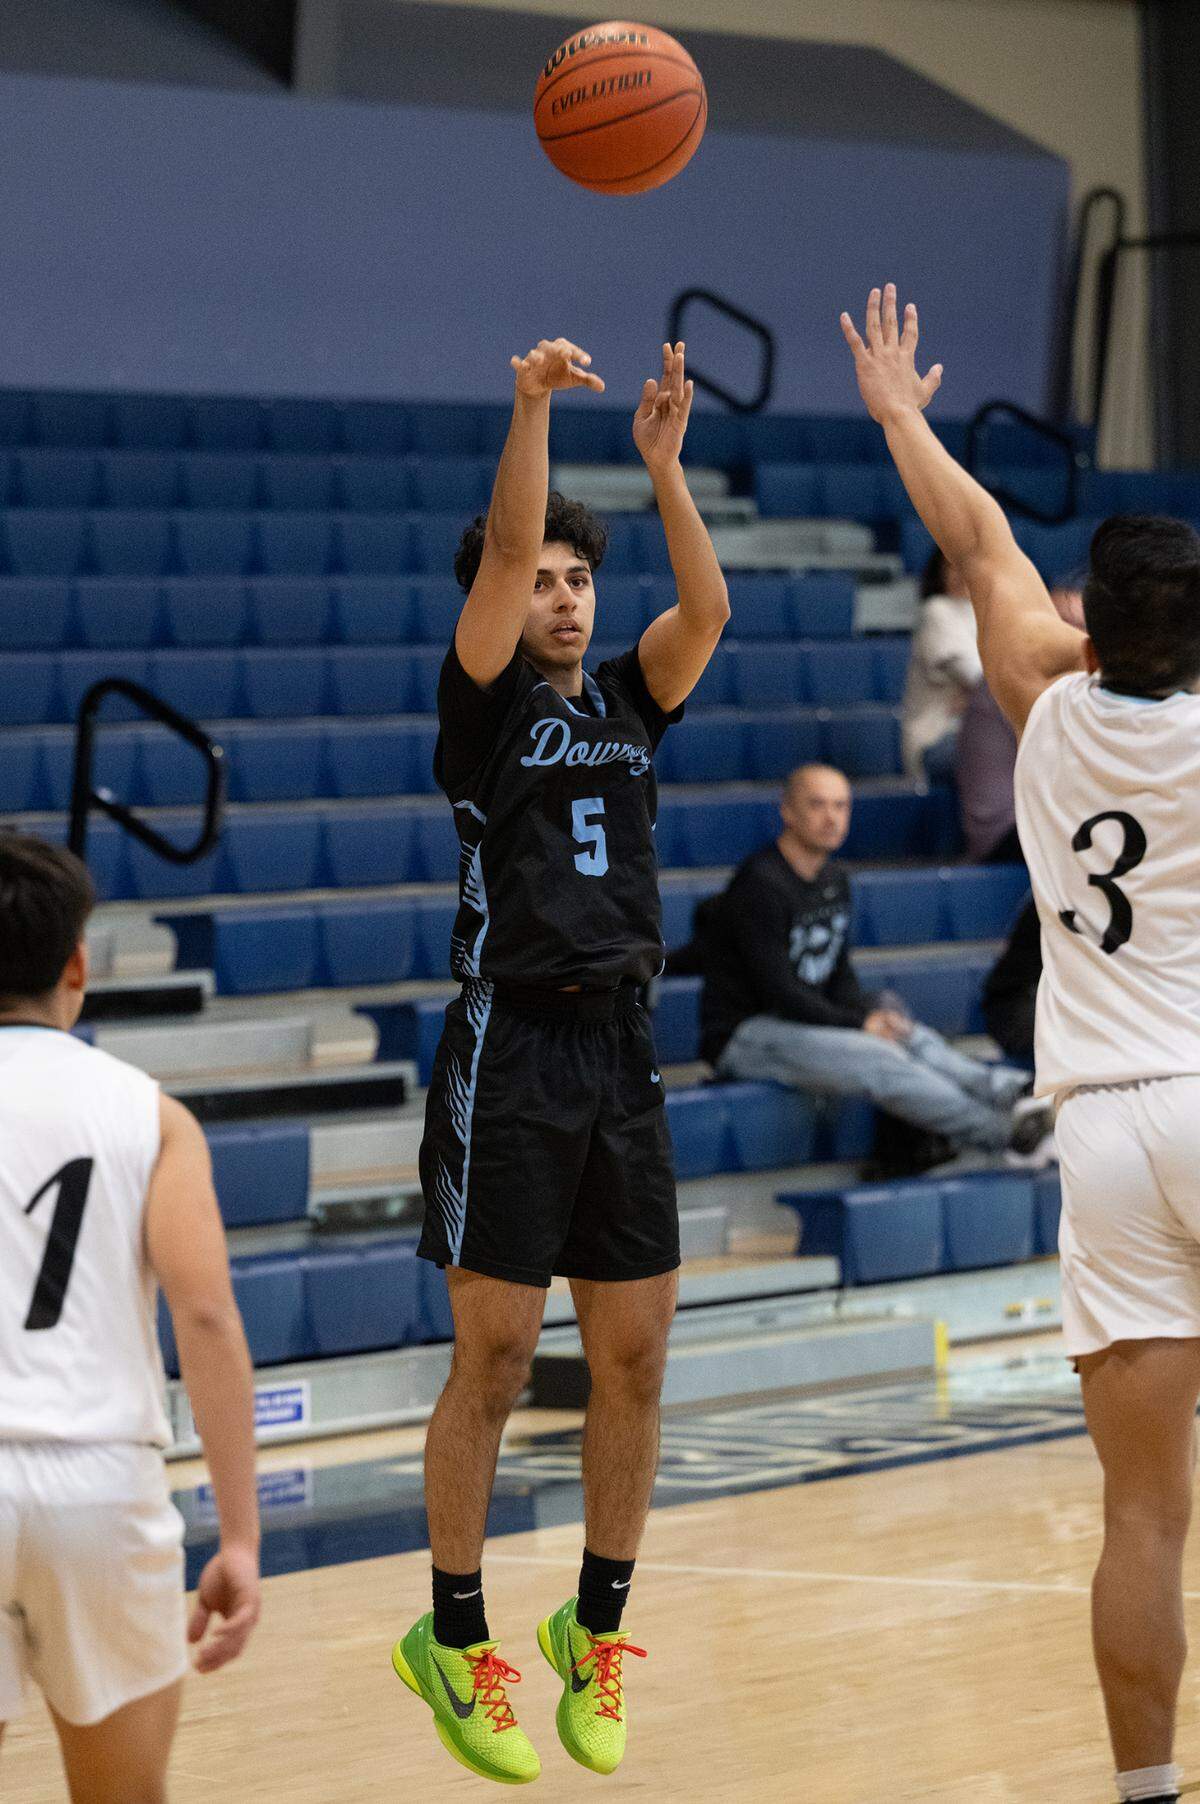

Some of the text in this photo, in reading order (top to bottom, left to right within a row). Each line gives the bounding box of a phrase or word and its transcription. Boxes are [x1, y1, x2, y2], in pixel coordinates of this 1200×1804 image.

[551, 70, 652, 115] EVOLUTION
[571, 797, 609, 877] 5
[1058, 810, 1147, 955] 3
[22, 1157, 95, 1331] 1
